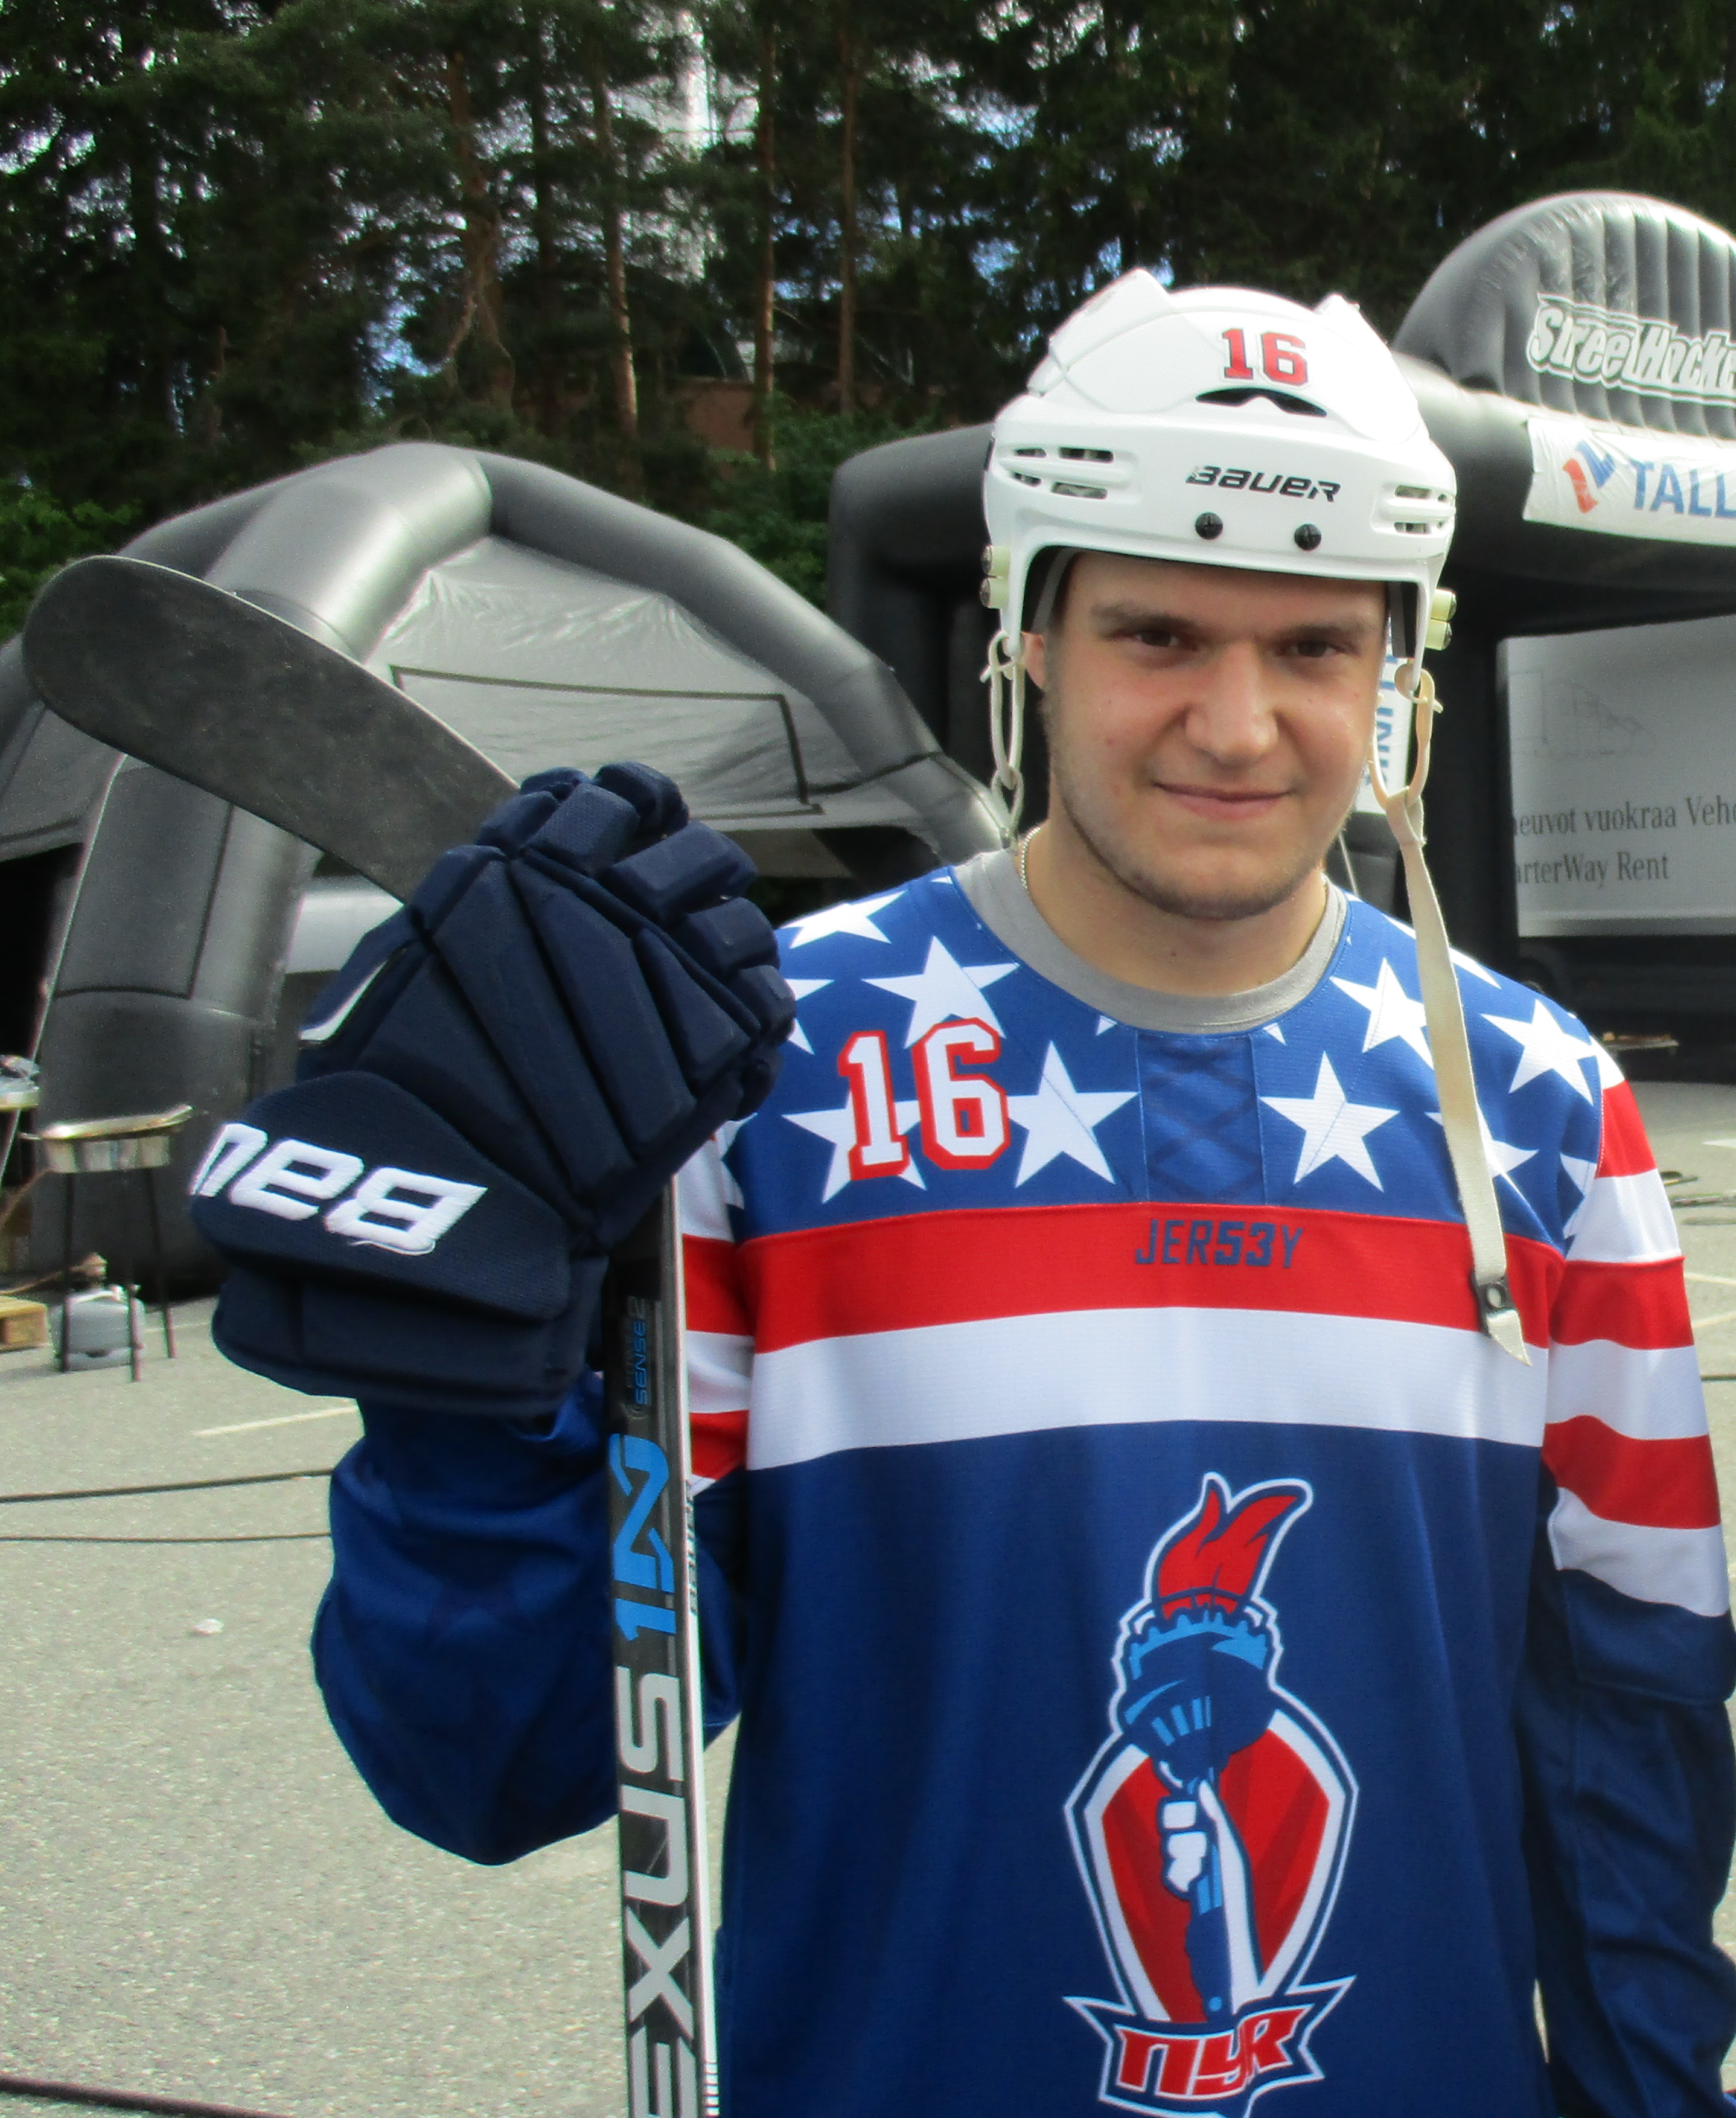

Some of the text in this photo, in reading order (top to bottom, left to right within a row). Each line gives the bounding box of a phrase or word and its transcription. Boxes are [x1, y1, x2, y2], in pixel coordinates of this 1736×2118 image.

[1222, 327, 1309, 387] 16
[1584, 801, 1676, 833] vuokraa
[1617, 851, 1670, 881] Rent
[837, 1017, 1011, 1182] 16
